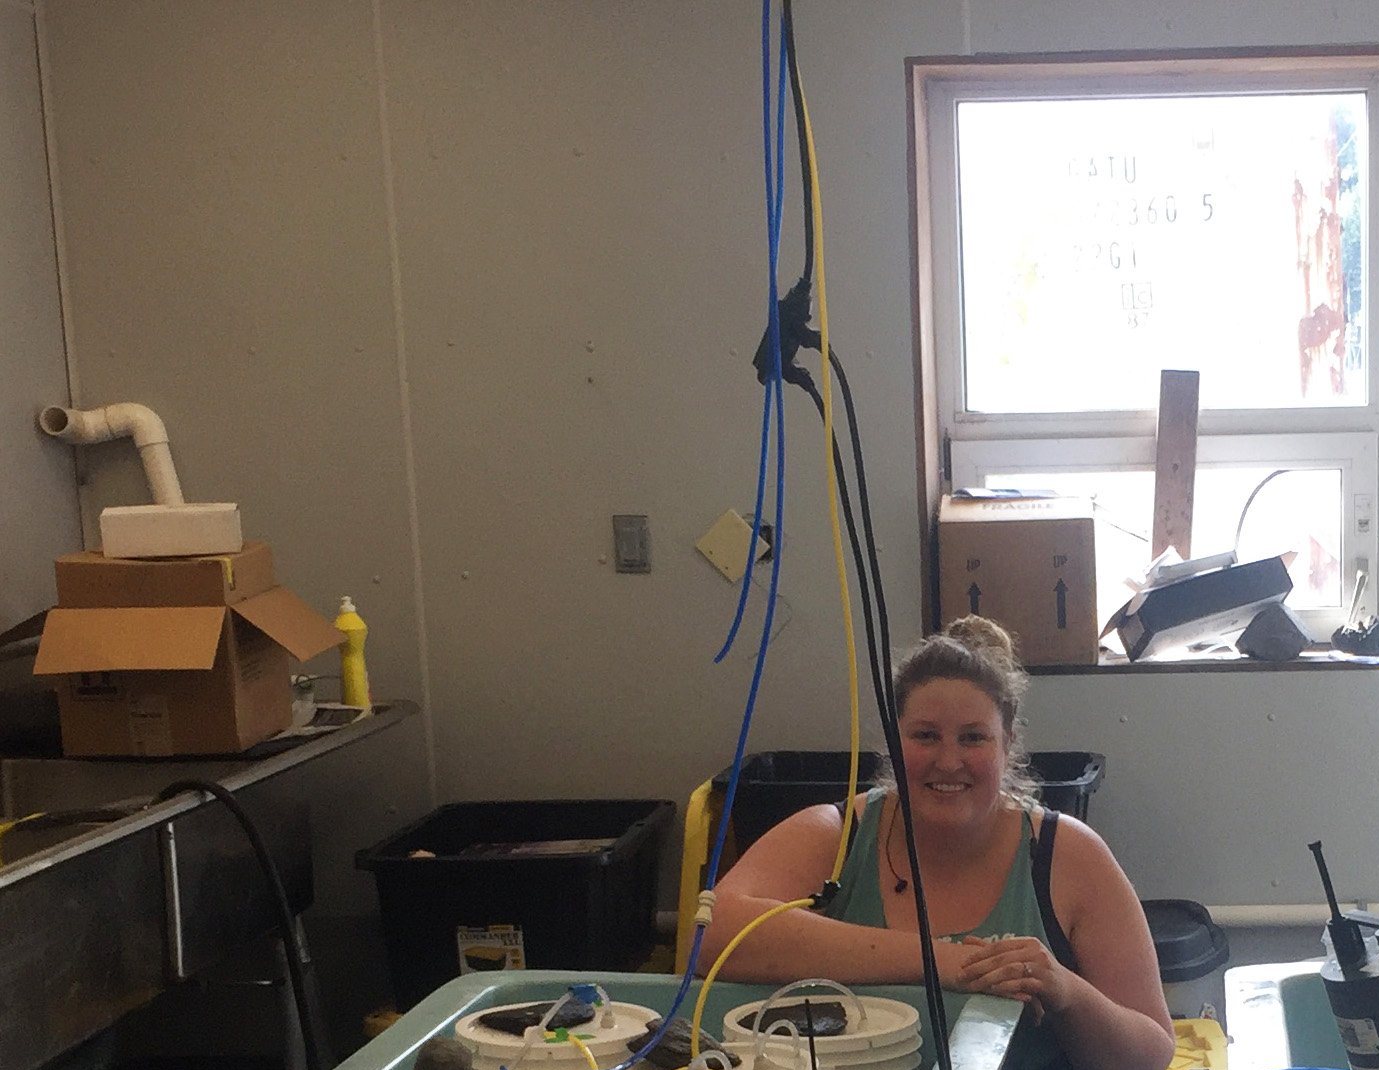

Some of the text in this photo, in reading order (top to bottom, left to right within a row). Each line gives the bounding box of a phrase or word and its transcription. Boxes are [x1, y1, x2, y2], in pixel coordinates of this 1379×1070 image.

[1202, 193, 1215, 222] 5
[980, 502, 1055, 512] FRAGILE
[966, 559, 981, 572] UP
[1053, 555, 1068, 569] UP
